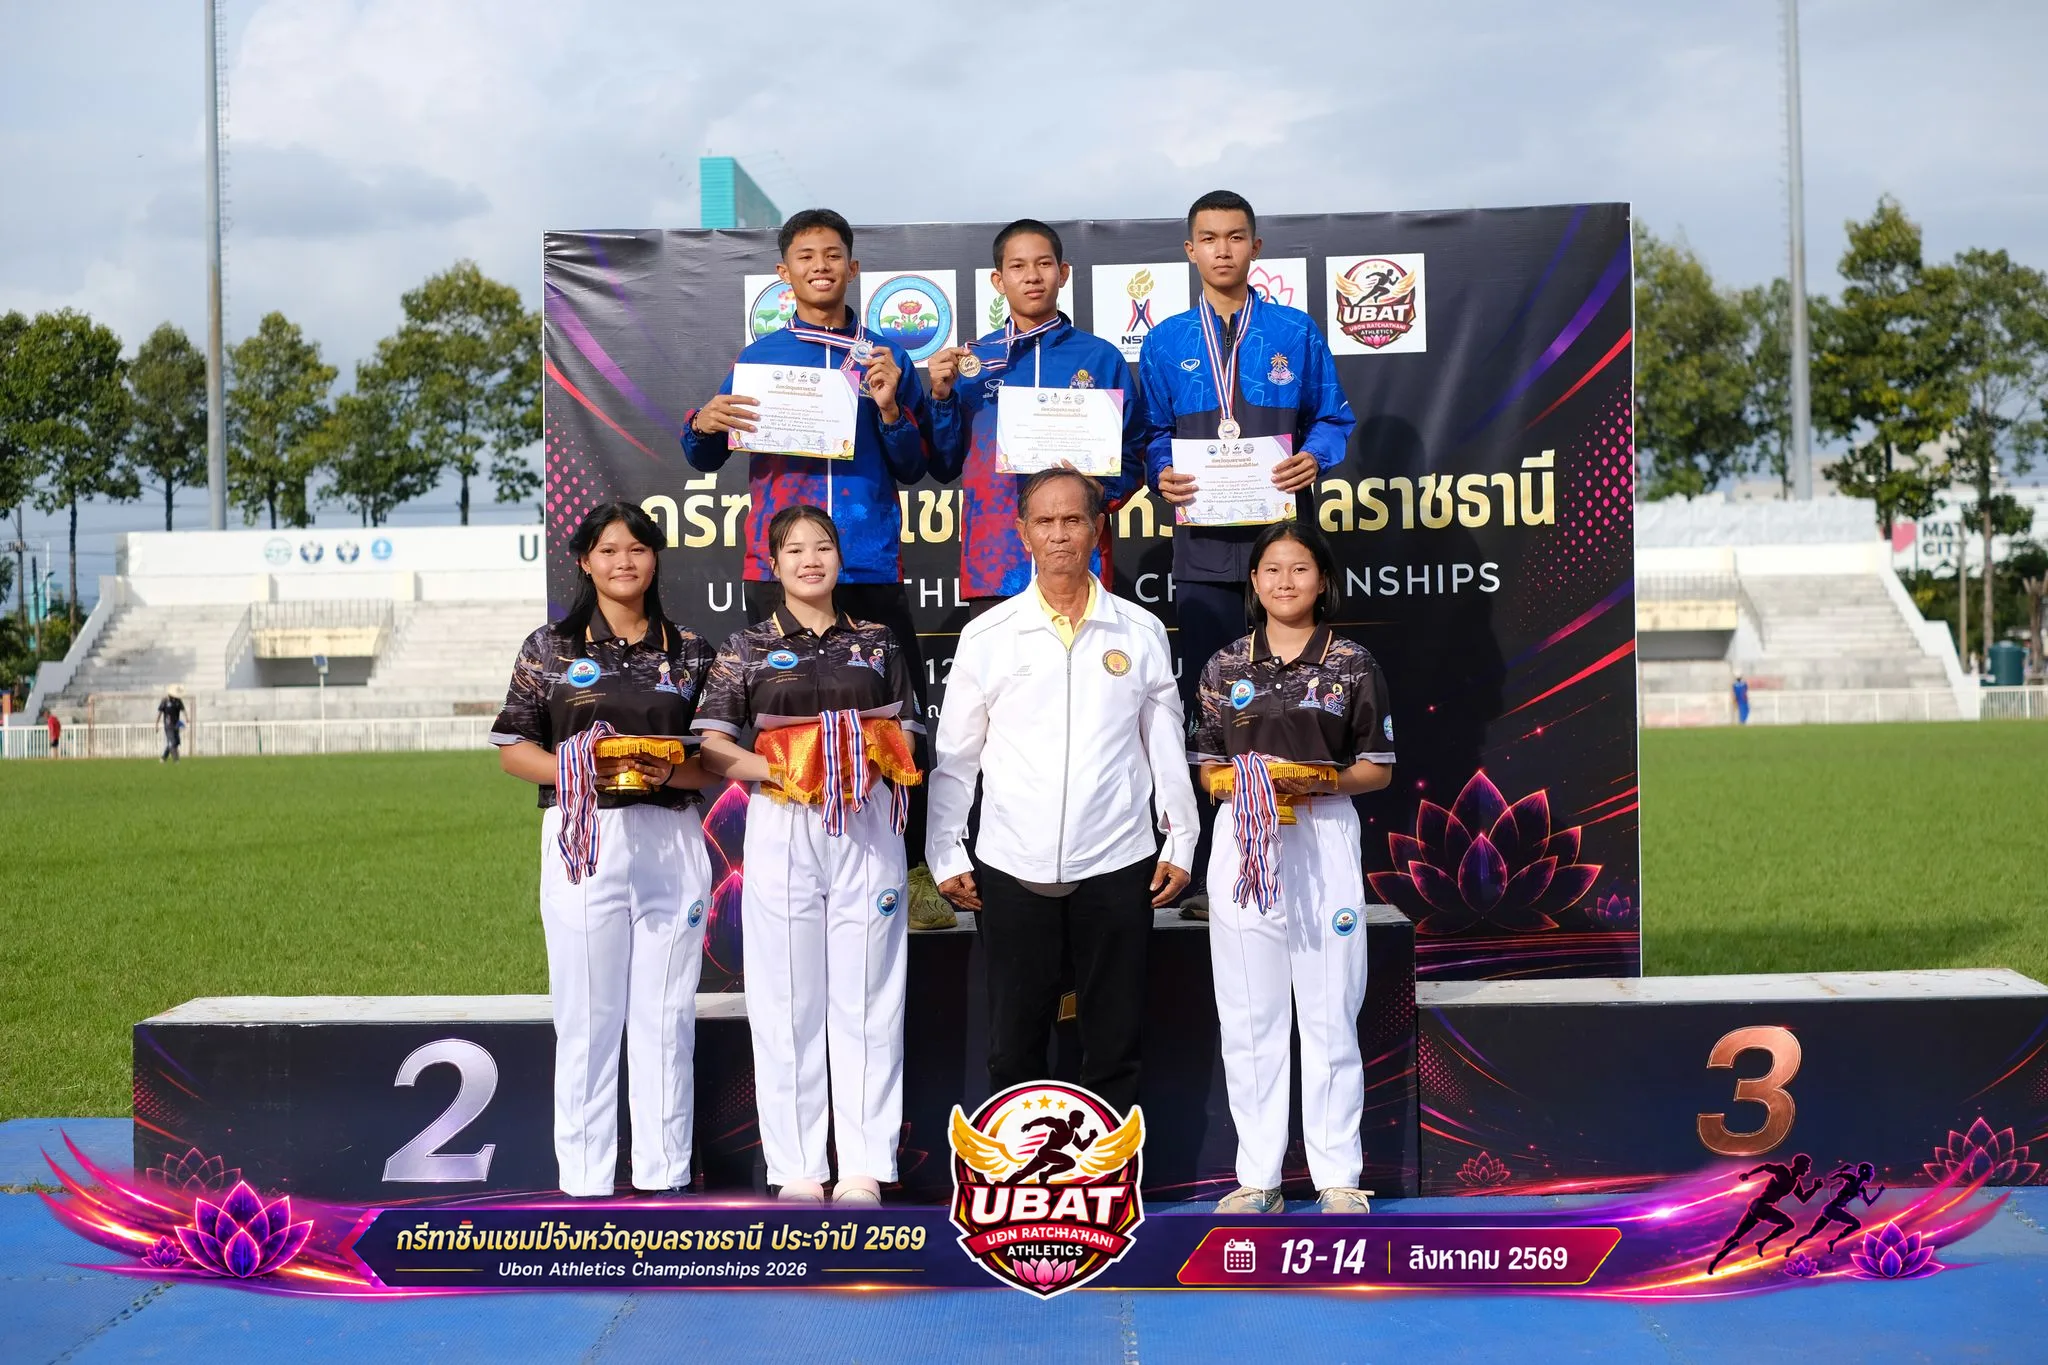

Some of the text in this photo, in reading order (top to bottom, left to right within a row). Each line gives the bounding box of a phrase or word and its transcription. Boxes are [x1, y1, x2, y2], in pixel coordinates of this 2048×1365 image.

[1342, 303, 1410, 323] UBAT
[1310, 449, 1555, 532] ลราชธานี
[382, 1040, 500, 1183] 2
[1695, 1026, 1802, 1157] 3
